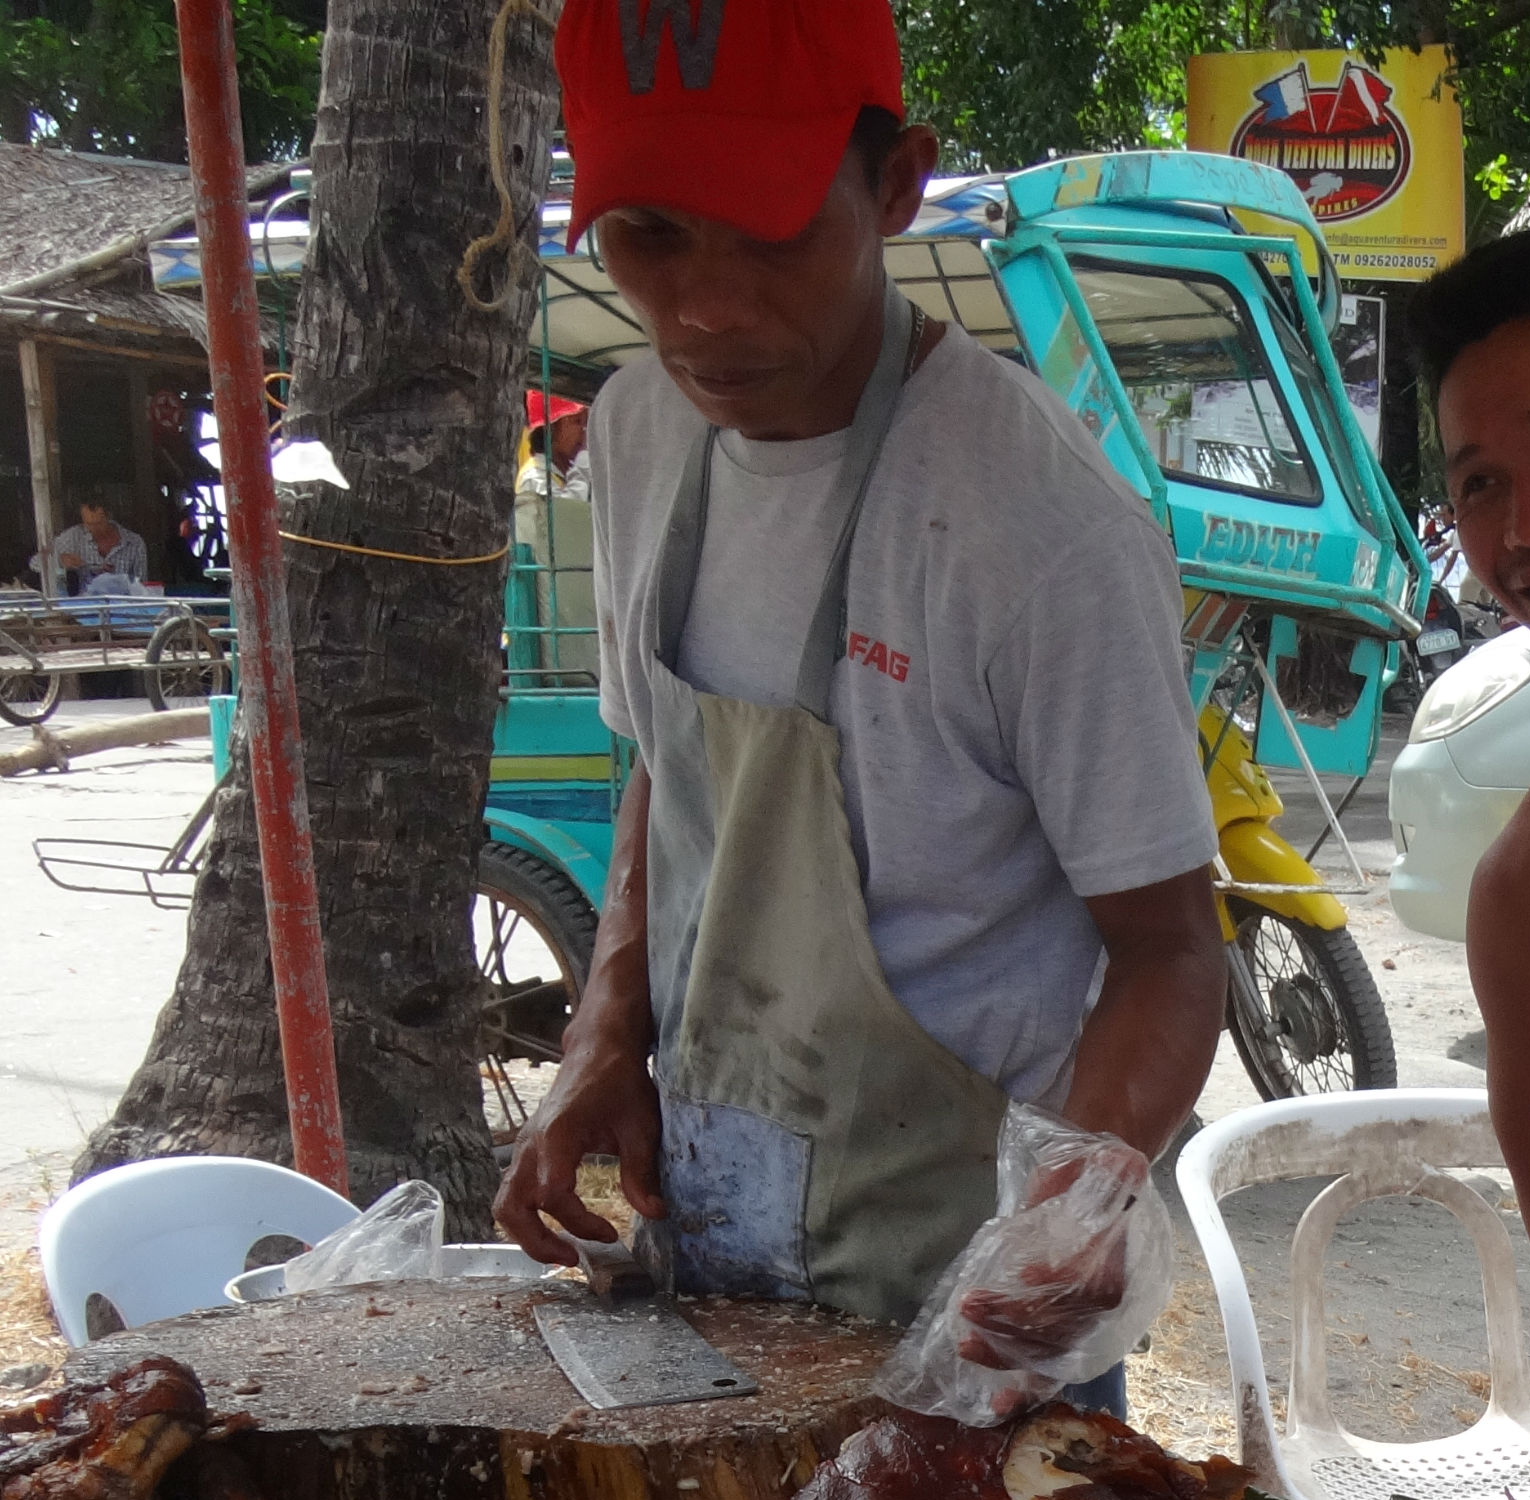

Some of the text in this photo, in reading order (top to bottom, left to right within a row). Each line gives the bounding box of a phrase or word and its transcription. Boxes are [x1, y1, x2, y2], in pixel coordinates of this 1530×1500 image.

[618, 0, 726, 95] W
[1348, 131, 1396, 170] DIVERS
[1354, 254, 1437, 269] 09262028052
[1196, 511, 1322, 582] EDITH
[848, 631, 912, 684] FAG
